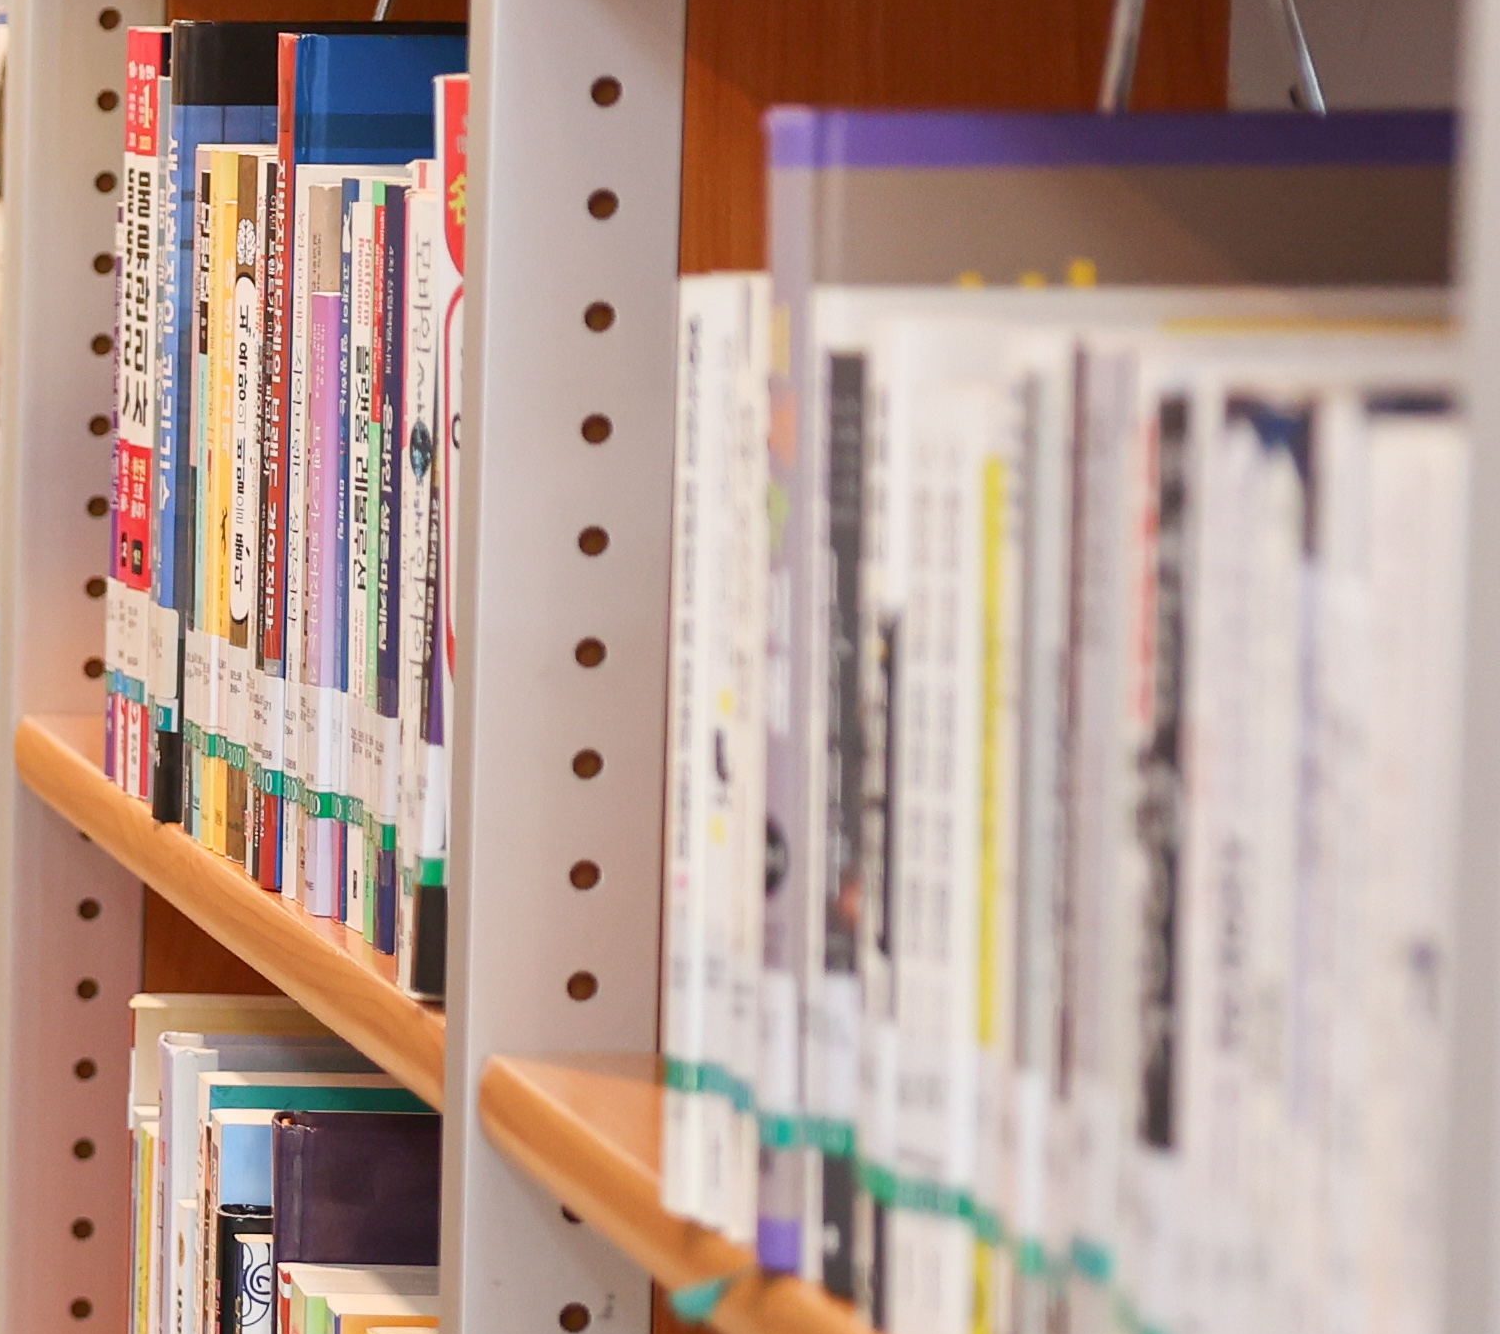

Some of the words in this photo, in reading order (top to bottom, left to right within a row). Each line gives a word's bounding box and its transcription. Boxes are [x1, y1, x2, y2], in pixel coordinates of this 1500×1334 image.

[272, 159, 287, 384] 지방자치단체의
[363, 237, 372, 326] Platform
[269, 397, 281, 487] 브랜드
[355, 346, 370, 444] 플랫폼
[352, 456, 368, 589] 레볼루션
